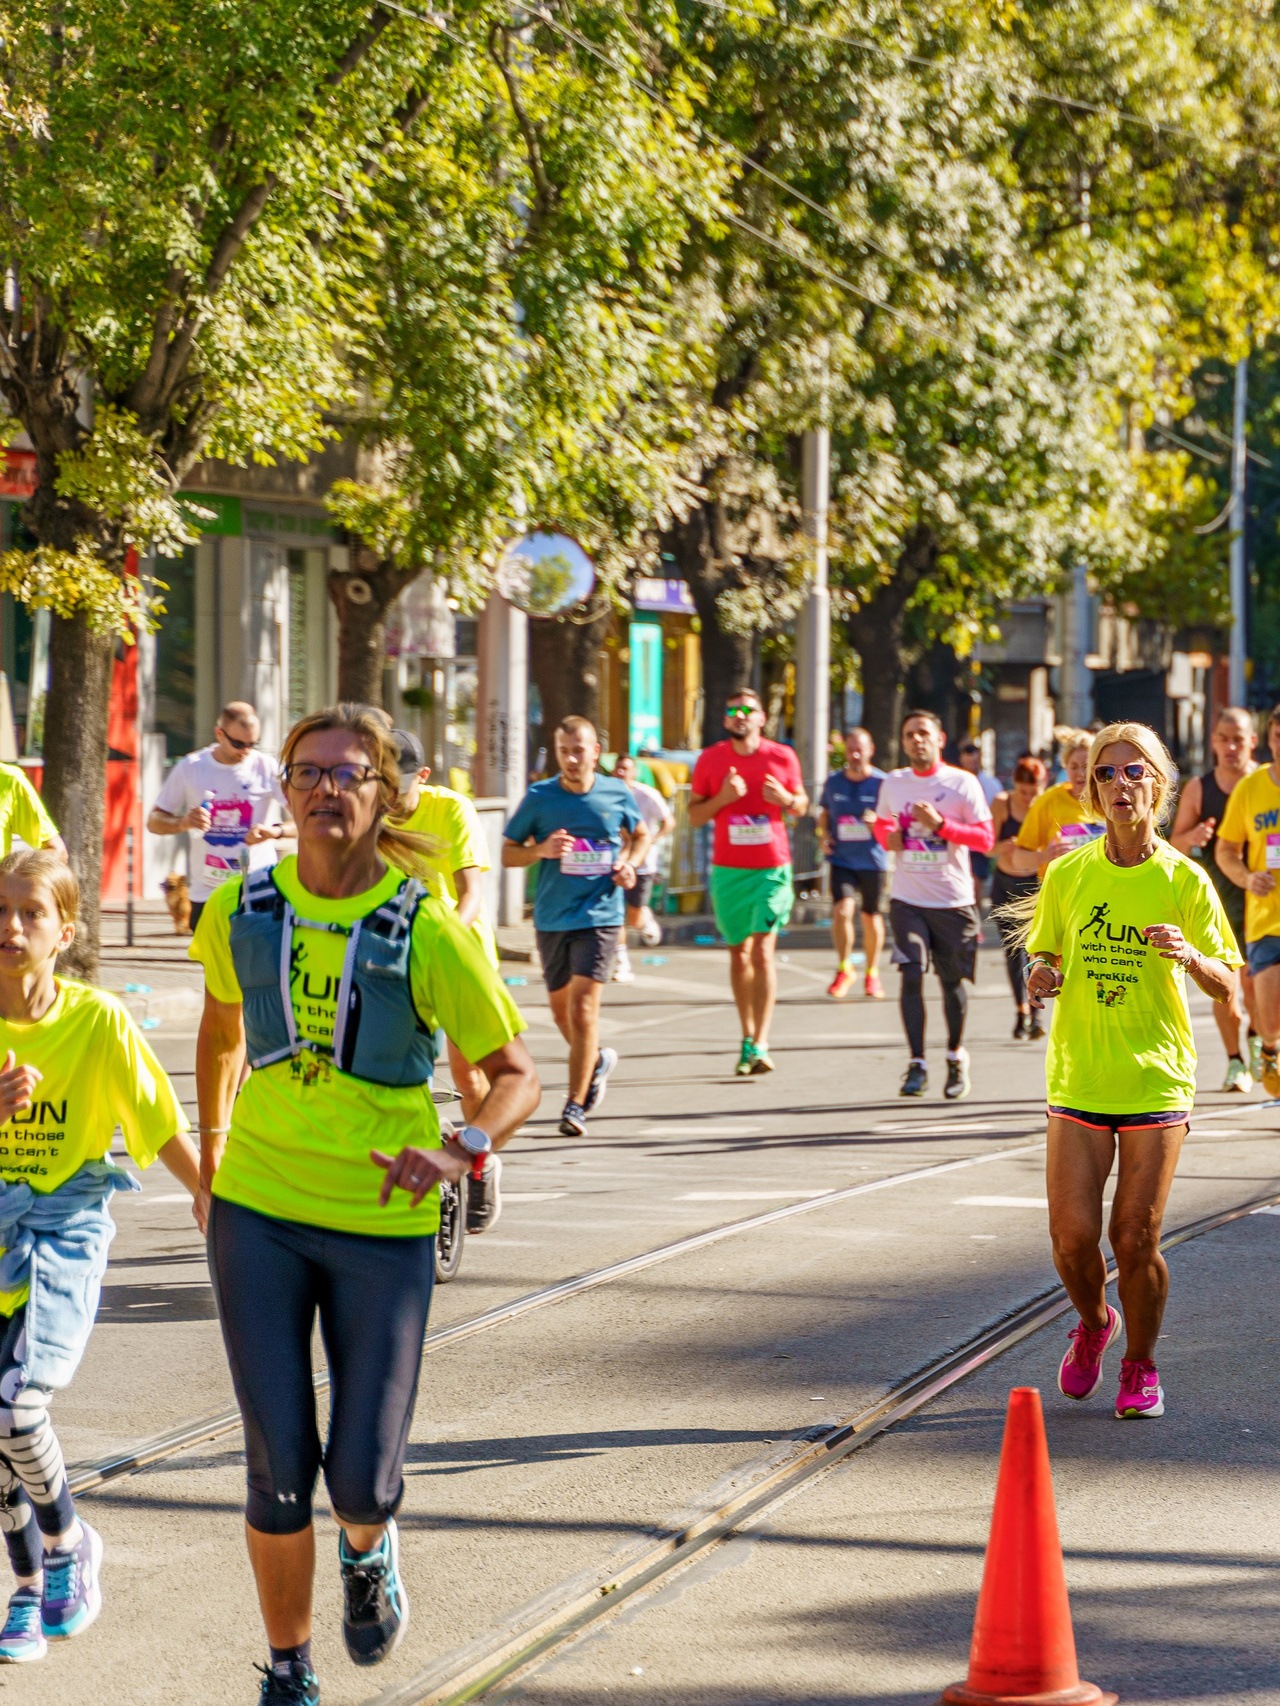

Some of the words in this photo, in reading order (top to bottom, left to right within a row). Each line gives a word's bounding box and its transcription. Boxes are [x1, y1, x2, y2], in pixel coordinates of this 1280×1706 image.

[573, 853, 603, 863] 3237
[912, 852, 938, 862] 3143
[1080, 942, 1107, 952] with
[1110, 945, 1147, 956] those
[1083, 955, 1107, 964] who
[1110, 958, 1143, 968] can't
[1086, 969, 1139, 983] ParaKids
[14, 1129, 65, 1141] those
[15, 1147, 59, 1157] can't
